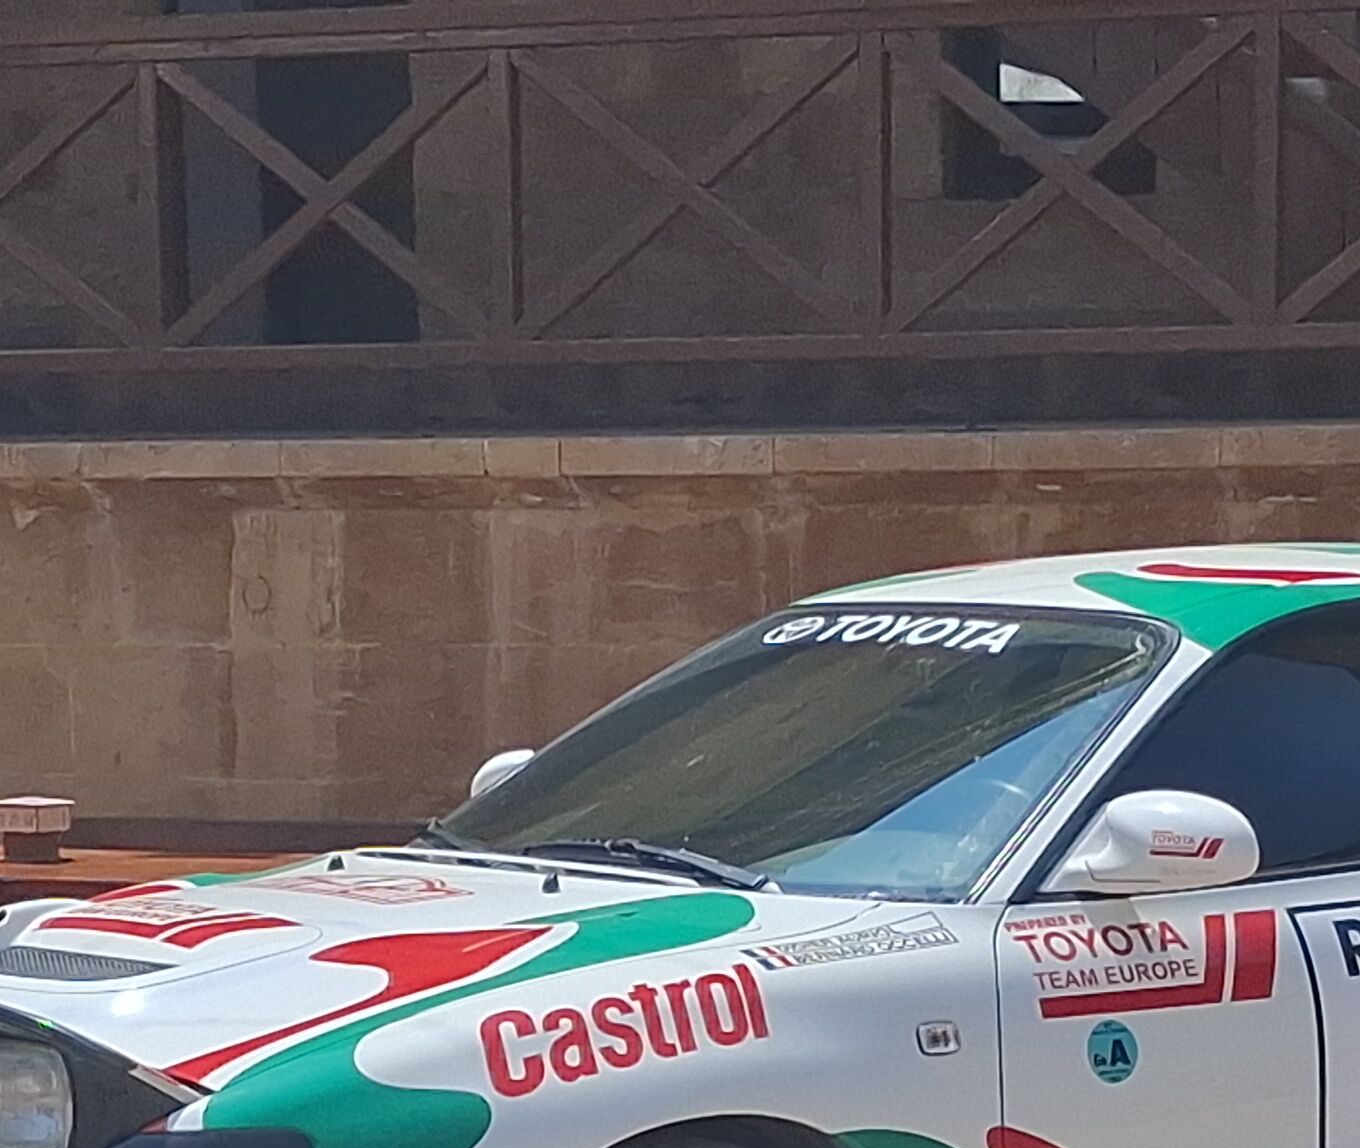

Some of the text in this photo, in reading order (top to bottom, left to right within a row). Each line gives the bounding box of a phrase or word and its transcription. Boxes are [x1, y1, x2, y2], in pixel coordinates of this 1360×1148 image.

[815, 614, 1022, 653] TOYOTA
[1011, 920, 1191, 965] TOYOTA
[1033, 957, 1200, 991] TEAM EUROPE
[479, 963, 770, 1099] Castrol
